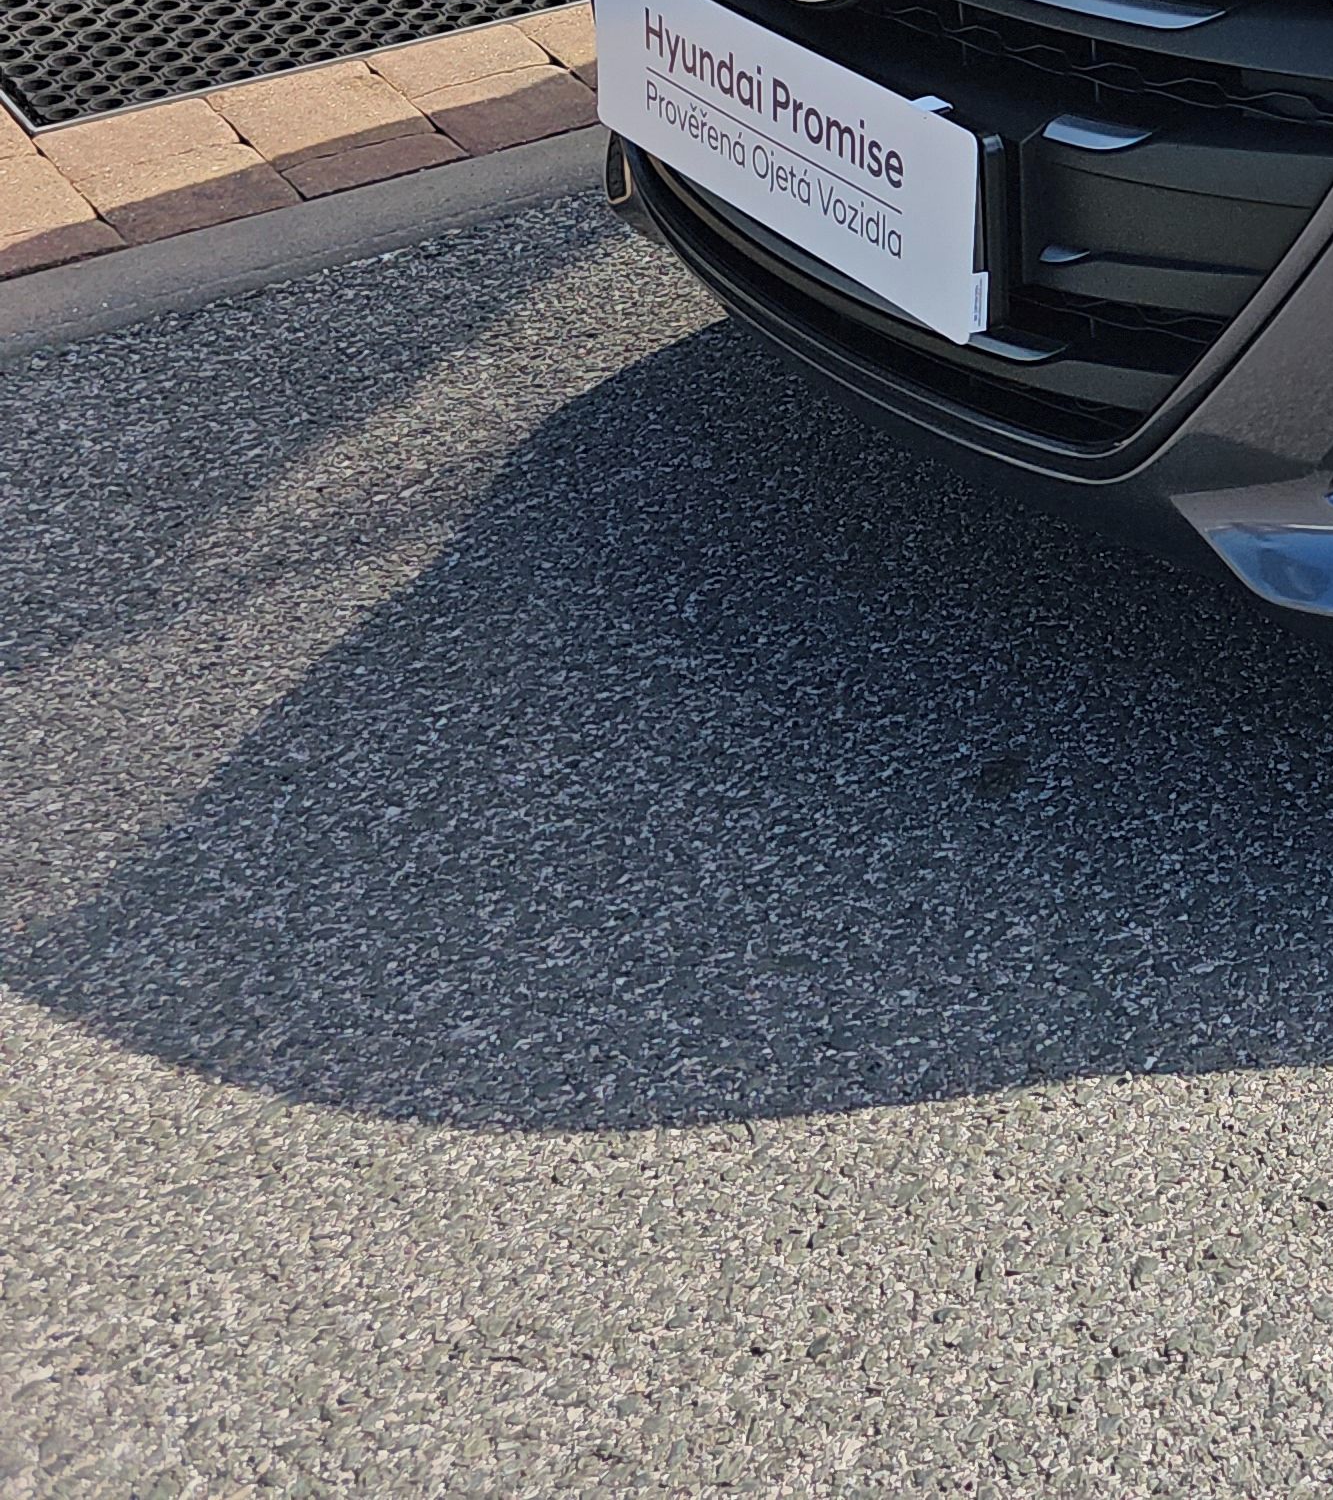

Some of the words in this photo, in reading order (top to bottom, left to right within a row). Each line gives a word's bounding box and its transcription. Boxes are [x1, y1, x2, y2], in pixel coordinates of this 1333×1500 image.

[644, 7, 764, 115] Hyundai
[772, 76, 905, 189] Promise
[645, 79, 748, 168] Prověřená
[752, 145, 813, 206] Ojetá
[817, 178, 903, 260] Vozidla
